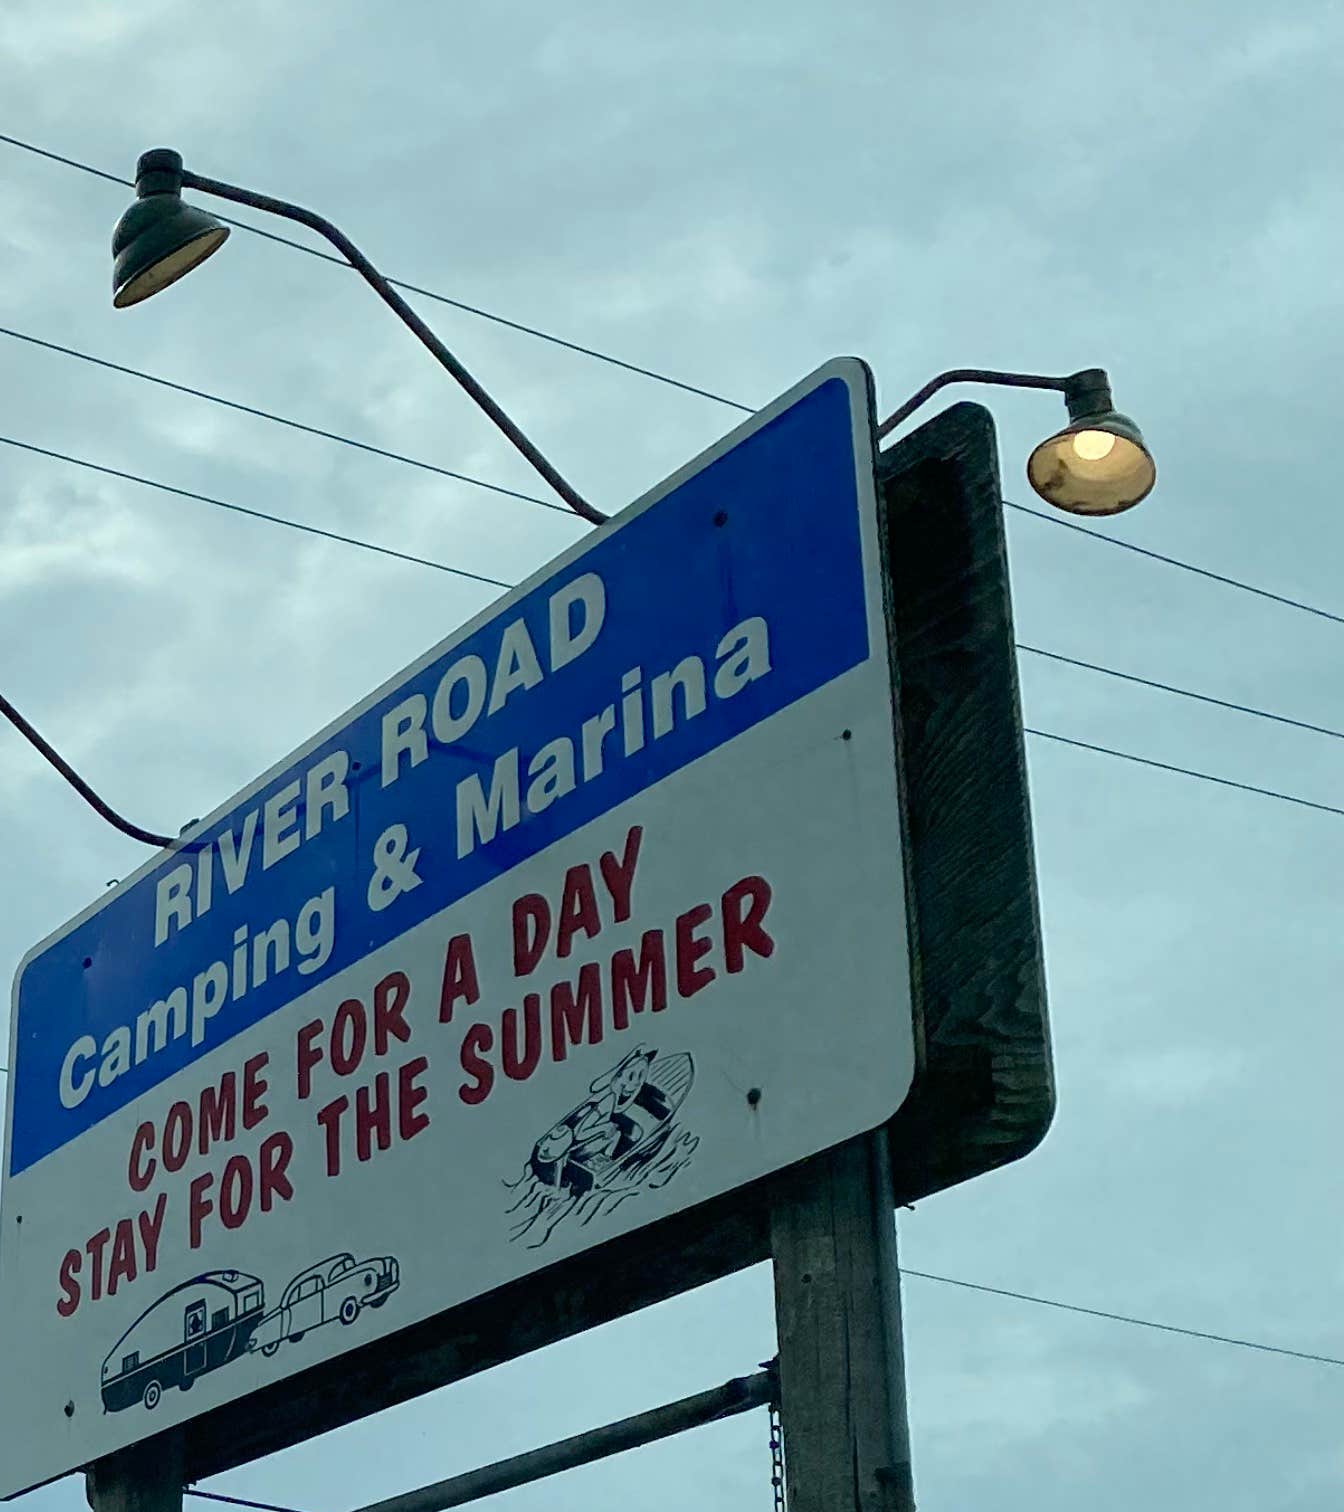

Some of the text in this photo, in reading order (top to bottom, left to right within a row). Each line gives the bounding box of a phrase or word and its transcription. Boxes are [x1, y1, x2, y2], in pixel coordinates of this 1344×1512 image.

[59, 617, 772, 1109] Camping & Marina
[154, 572, 606, 947] RIVER ROAD
[57, 876, 775, 1317] STAY FOR THE SUMMER
[128, 825, 643, 1192] COME FOR A DAY
